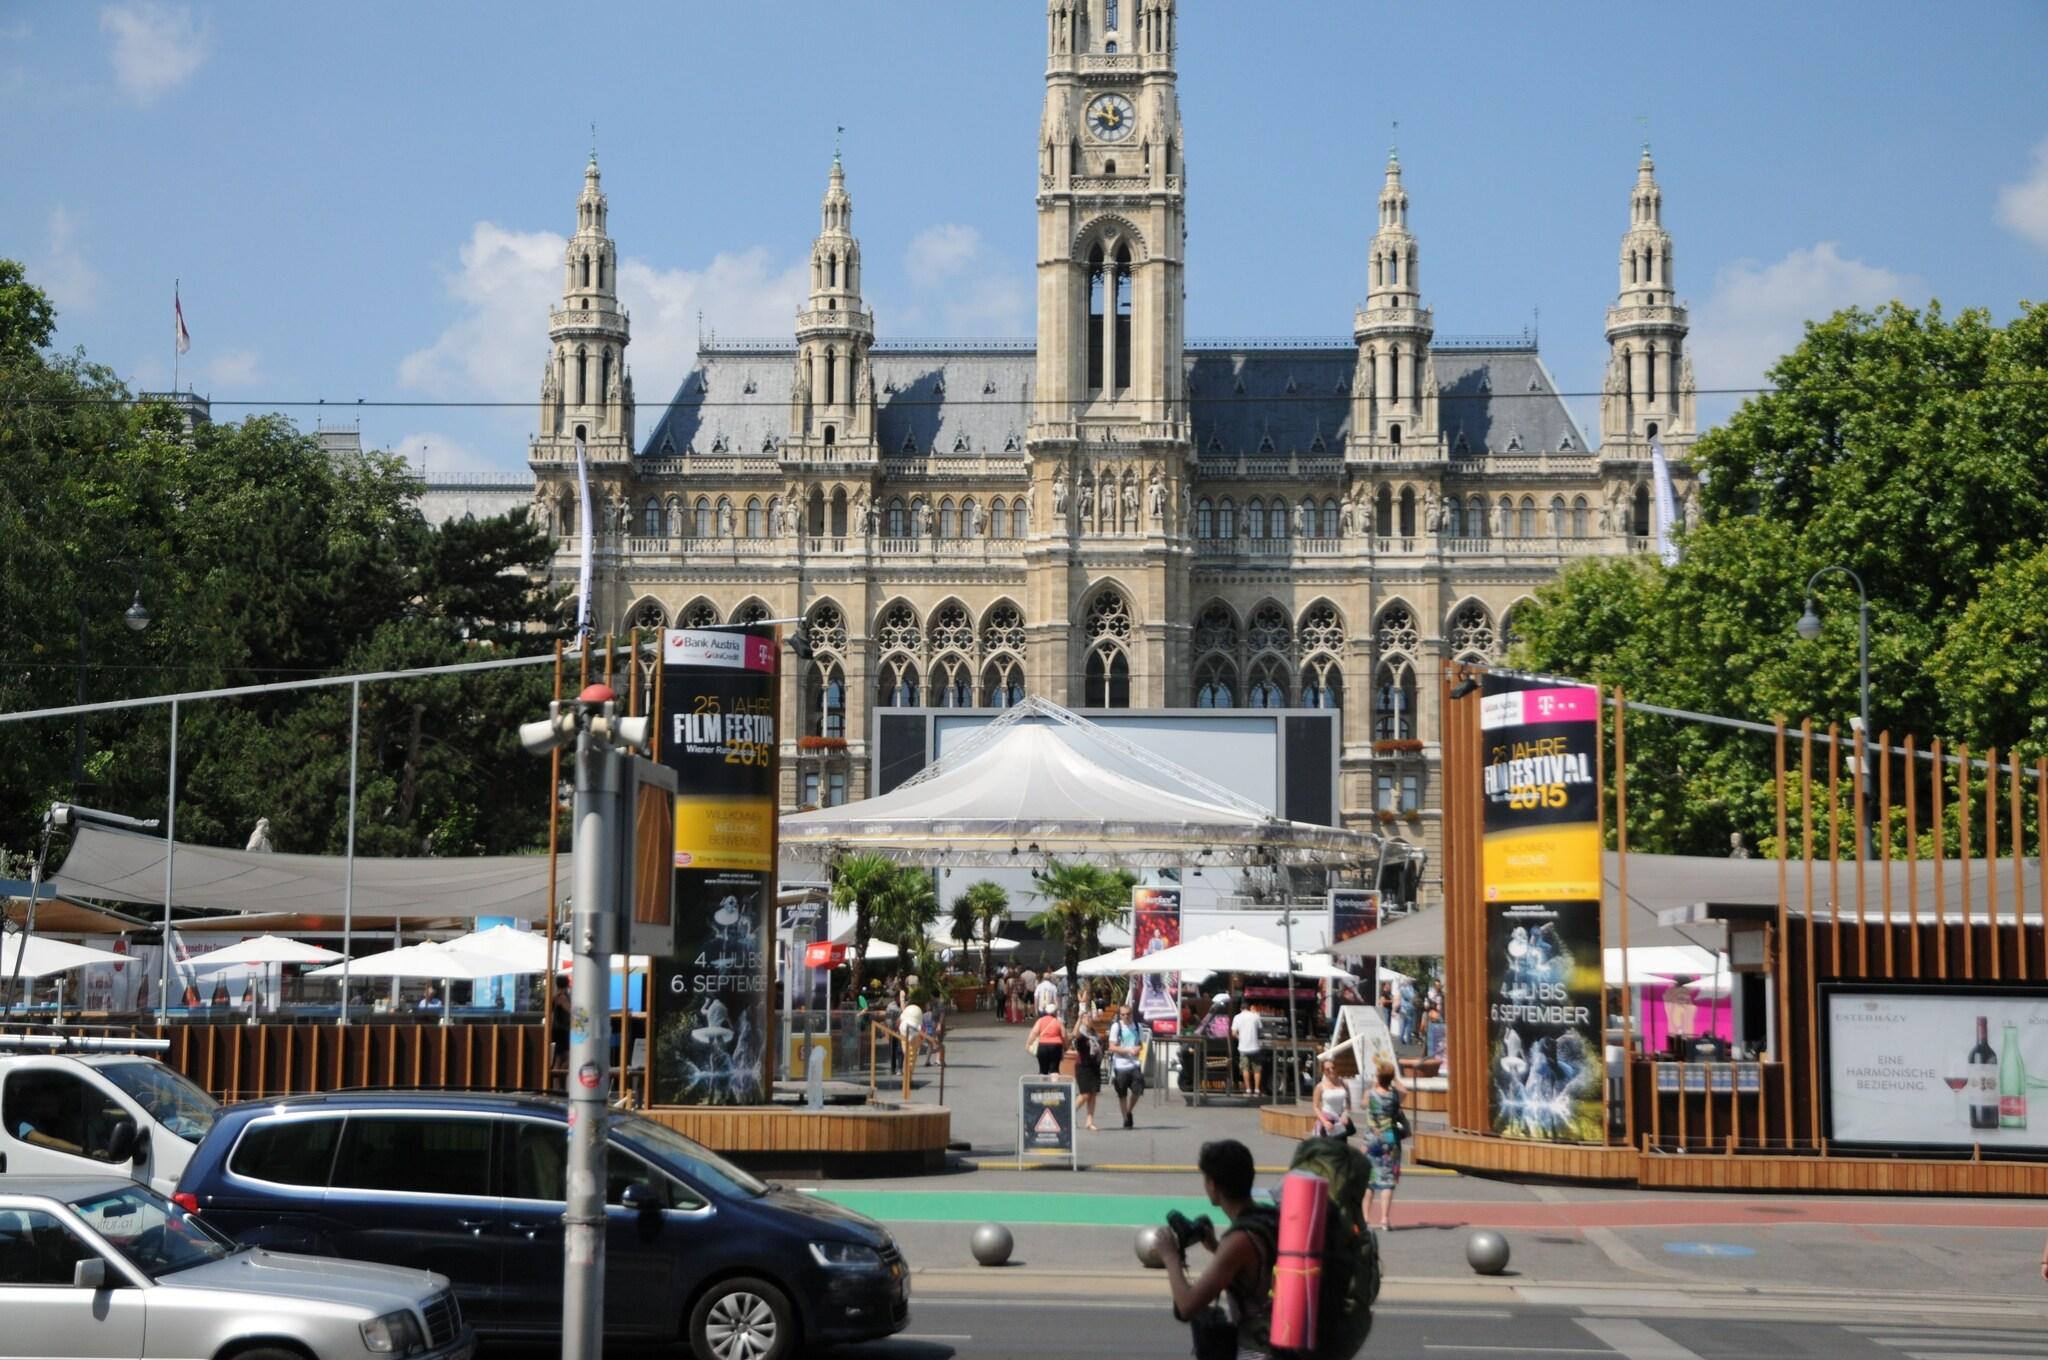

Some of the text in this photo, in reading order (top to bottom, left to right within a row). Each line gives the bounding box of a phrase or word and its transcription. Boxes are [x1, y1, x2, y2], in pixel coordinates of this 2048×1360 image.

[684, 637, 740, 651] Bank Austria
[694, 695, 720, 715] 25
[673, 713, 722, 744] FILM
[686, 744, 714, 754] Wiener
[725, 738, 770, 767] 2015
[1511, 737, 1568, 761] JAHRE
[1508, 752, 1593, 788] FESTIVAL
[1509, 782, 1568, 810] 2015
[694, 952, 710, 968] 4.
[671, 974, 688, 993] 6.
[1540, 983, 1568, 1001] BIS
[1500, 1004, 1590, 1025] SEPTEMBER
[1877, 1055, 1904, 1065] EINE
[1846, 1068, 1936, 1080] HARMONISCHE
